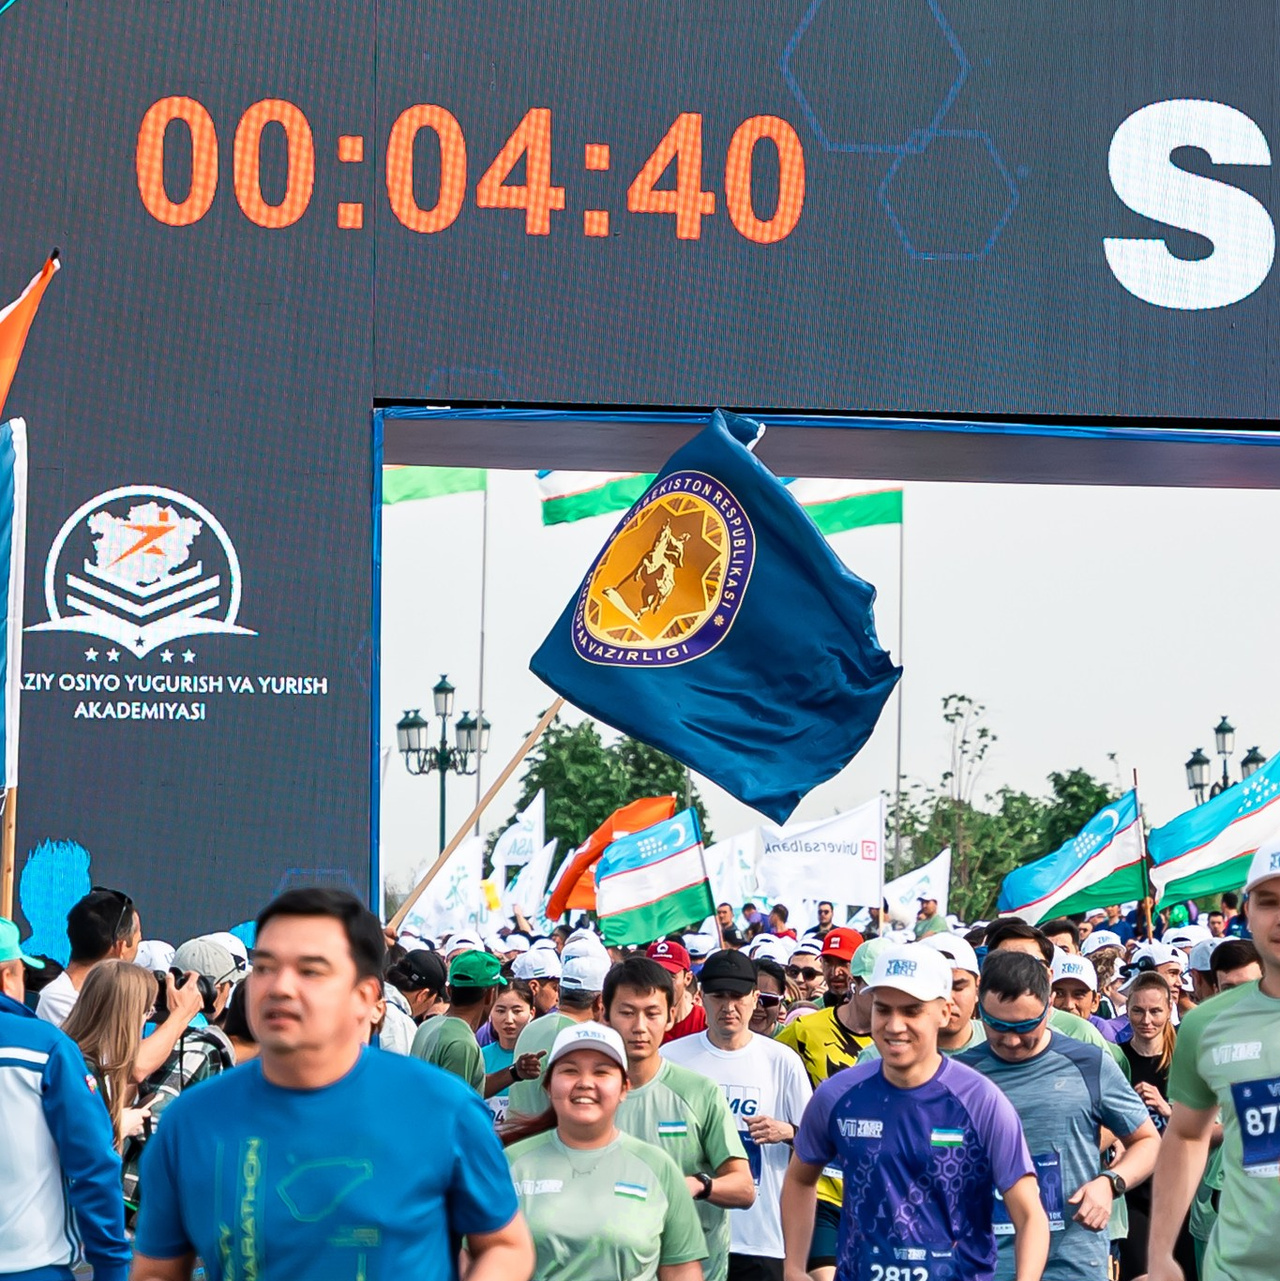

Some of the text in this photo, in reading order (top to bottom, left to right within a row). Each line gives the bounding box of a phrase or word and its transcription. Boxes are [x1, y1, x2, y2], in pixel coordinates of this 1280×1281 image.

[135, 95, 806, 245] 00:04:40
[587, 644, 690, 662] VAZIRLIGI
[59, 674, 121, 692] OSIYO
[125, 674, 224, 694] YUGURISH
[228, 676, 255, 694] VA
[258, 676, 329, 696] YURISH
[74, 702, 206, 721] AKADEMIYASI
